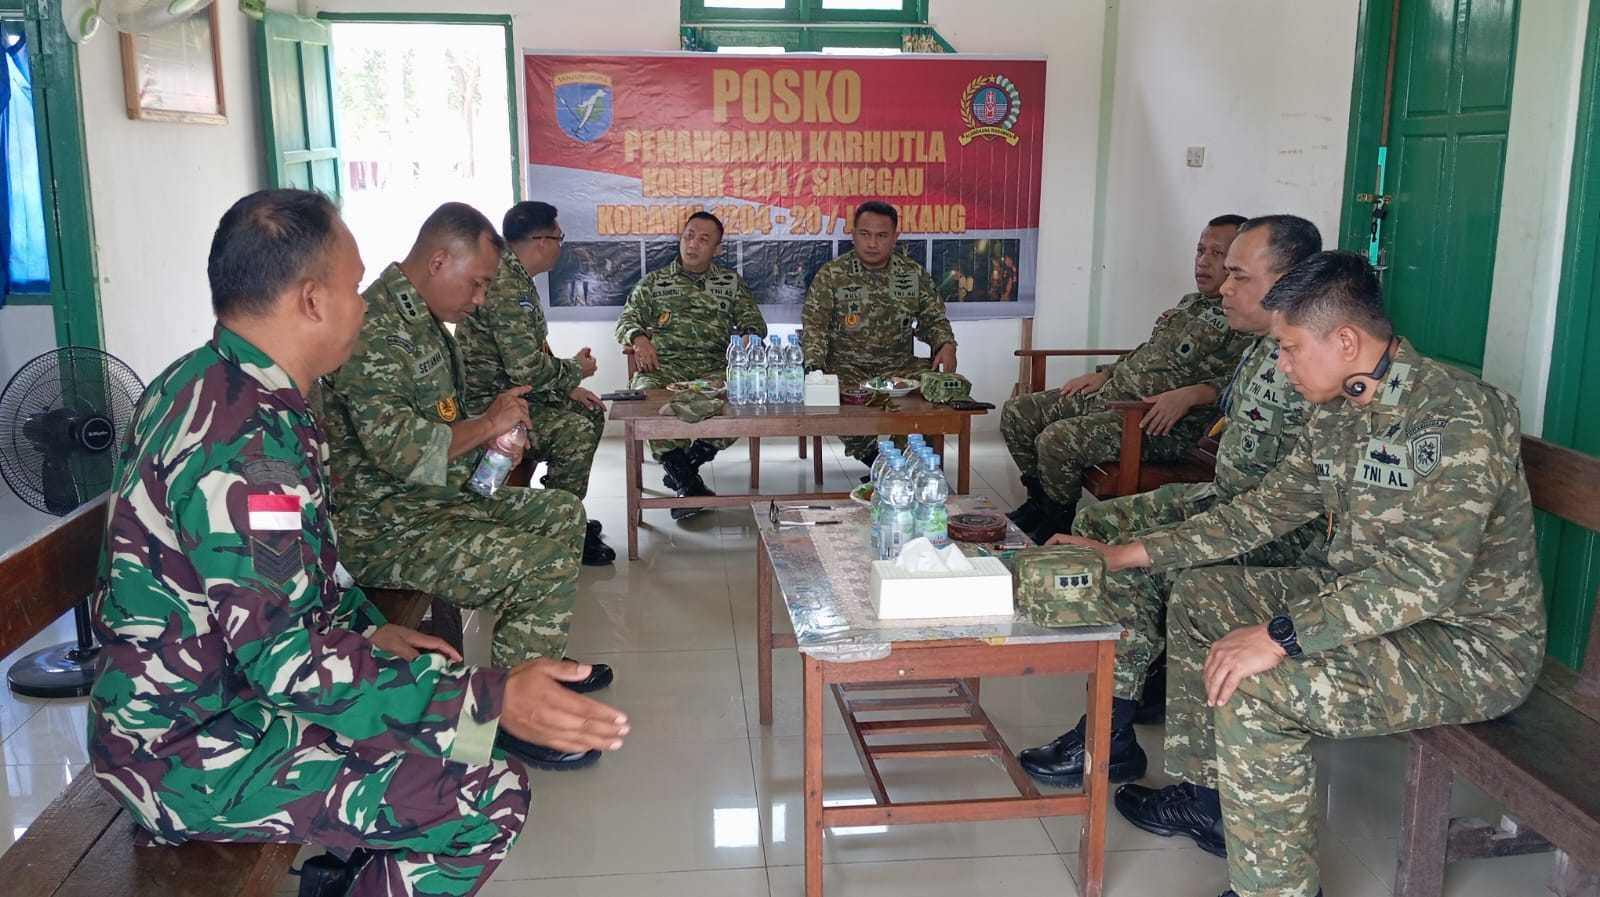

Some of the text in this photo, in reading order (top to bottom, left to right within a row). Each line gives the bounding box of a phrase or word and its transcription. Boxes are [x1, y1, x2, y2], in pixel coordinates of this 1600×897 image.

[713, 69, 862, 124] POSKO
[625, 130, 946, 163] PENANGANAN KARHUTLA
[642, 167, 924, 198] KODIM 1204 / SANGGAU
[597, 205, 704, 234] KORAM
[775, 215, 786, 224] -
[790, 204, 822, 235] 20
[826, 204, 840, 234] /
[1209, 318, 1224, 330] AU
[1248, 381, 1279, 404] TNI AL
[1363, 463, 1408, 488] TNI AL
